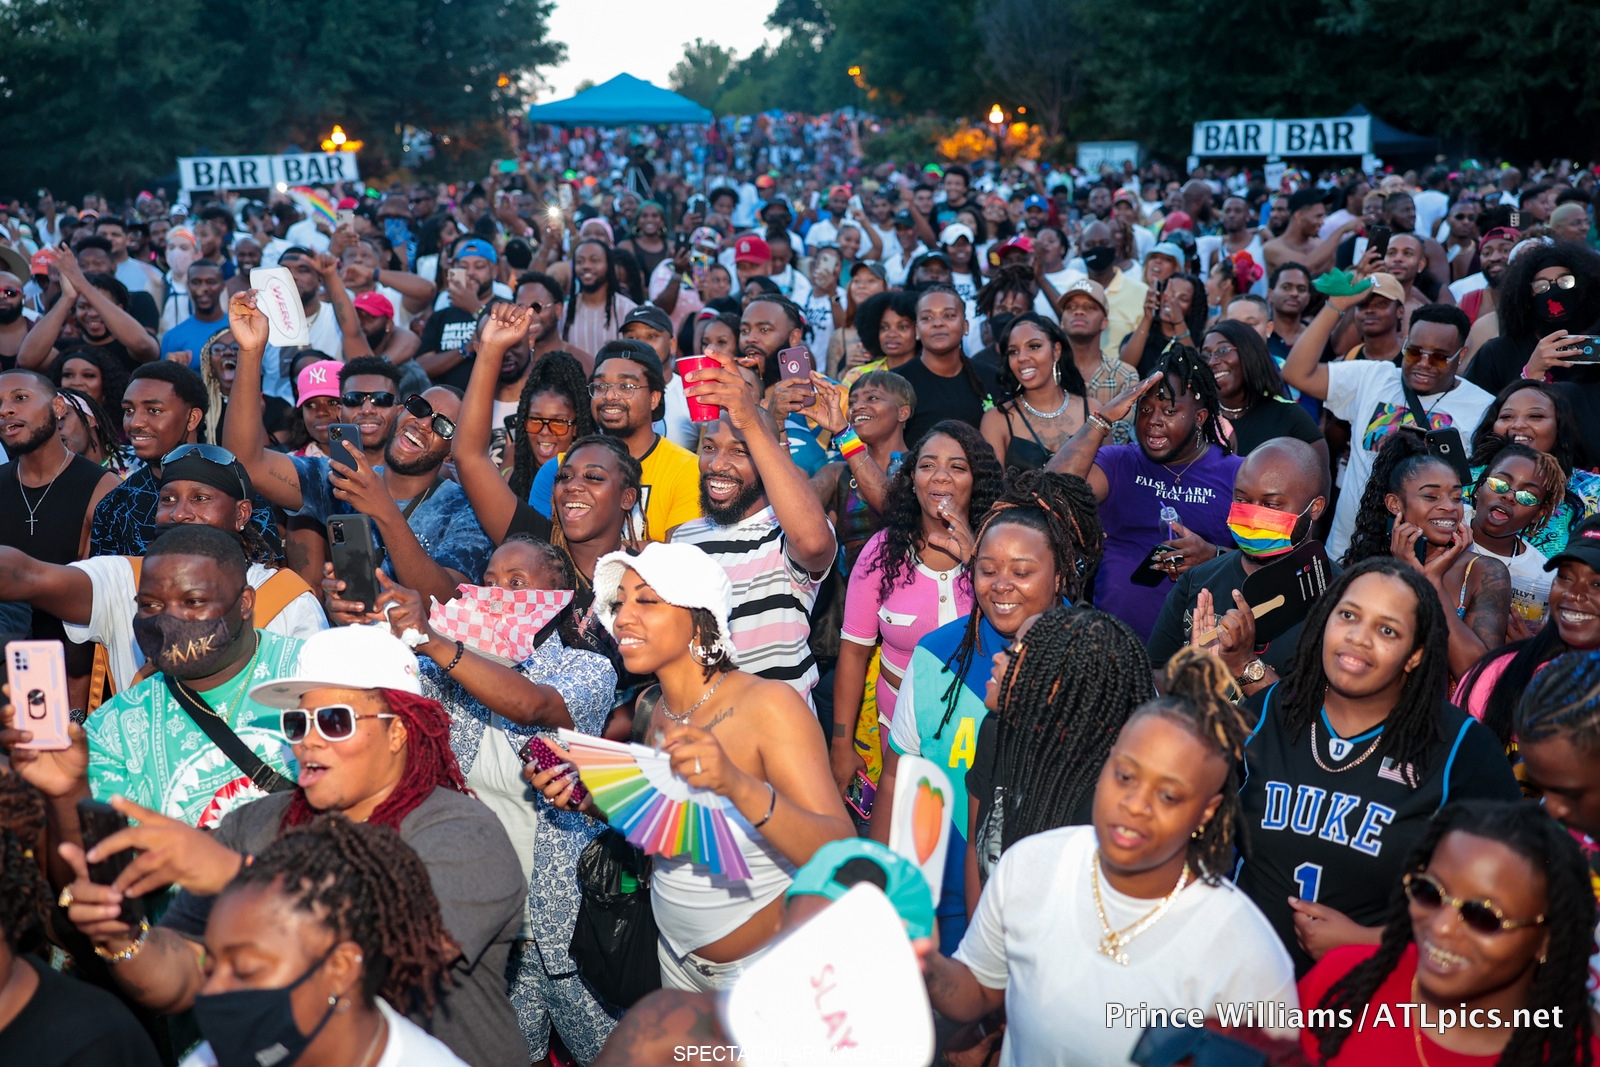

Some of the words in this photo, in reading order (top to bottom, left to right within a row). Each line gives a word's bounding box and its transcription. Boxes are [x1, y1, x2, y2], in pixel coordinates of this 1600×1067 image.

[1204, 124, 1261, 151] BAR
[1287, 121, 1354, 151] BAR
[193, 160, 258, 186] BAR
[283, 156, 345, 183] BAR
[272, 285, 294, 332] WERK
[309, 366, 327, 385] NY
[1135, 475, 1167, 491] FALSE
[1170, 485, 1216, 499] ALARM,
[1155, 489, 1181, 502] FUCK
[1184, 494, 1209, 505] HIM.
[1333, 742, 1345, 756] D
[1261, 781, 1397, 857] DUKE
[1293, 861, 1324, 902] 1
[810, 963, 859, 1053] SLAY
